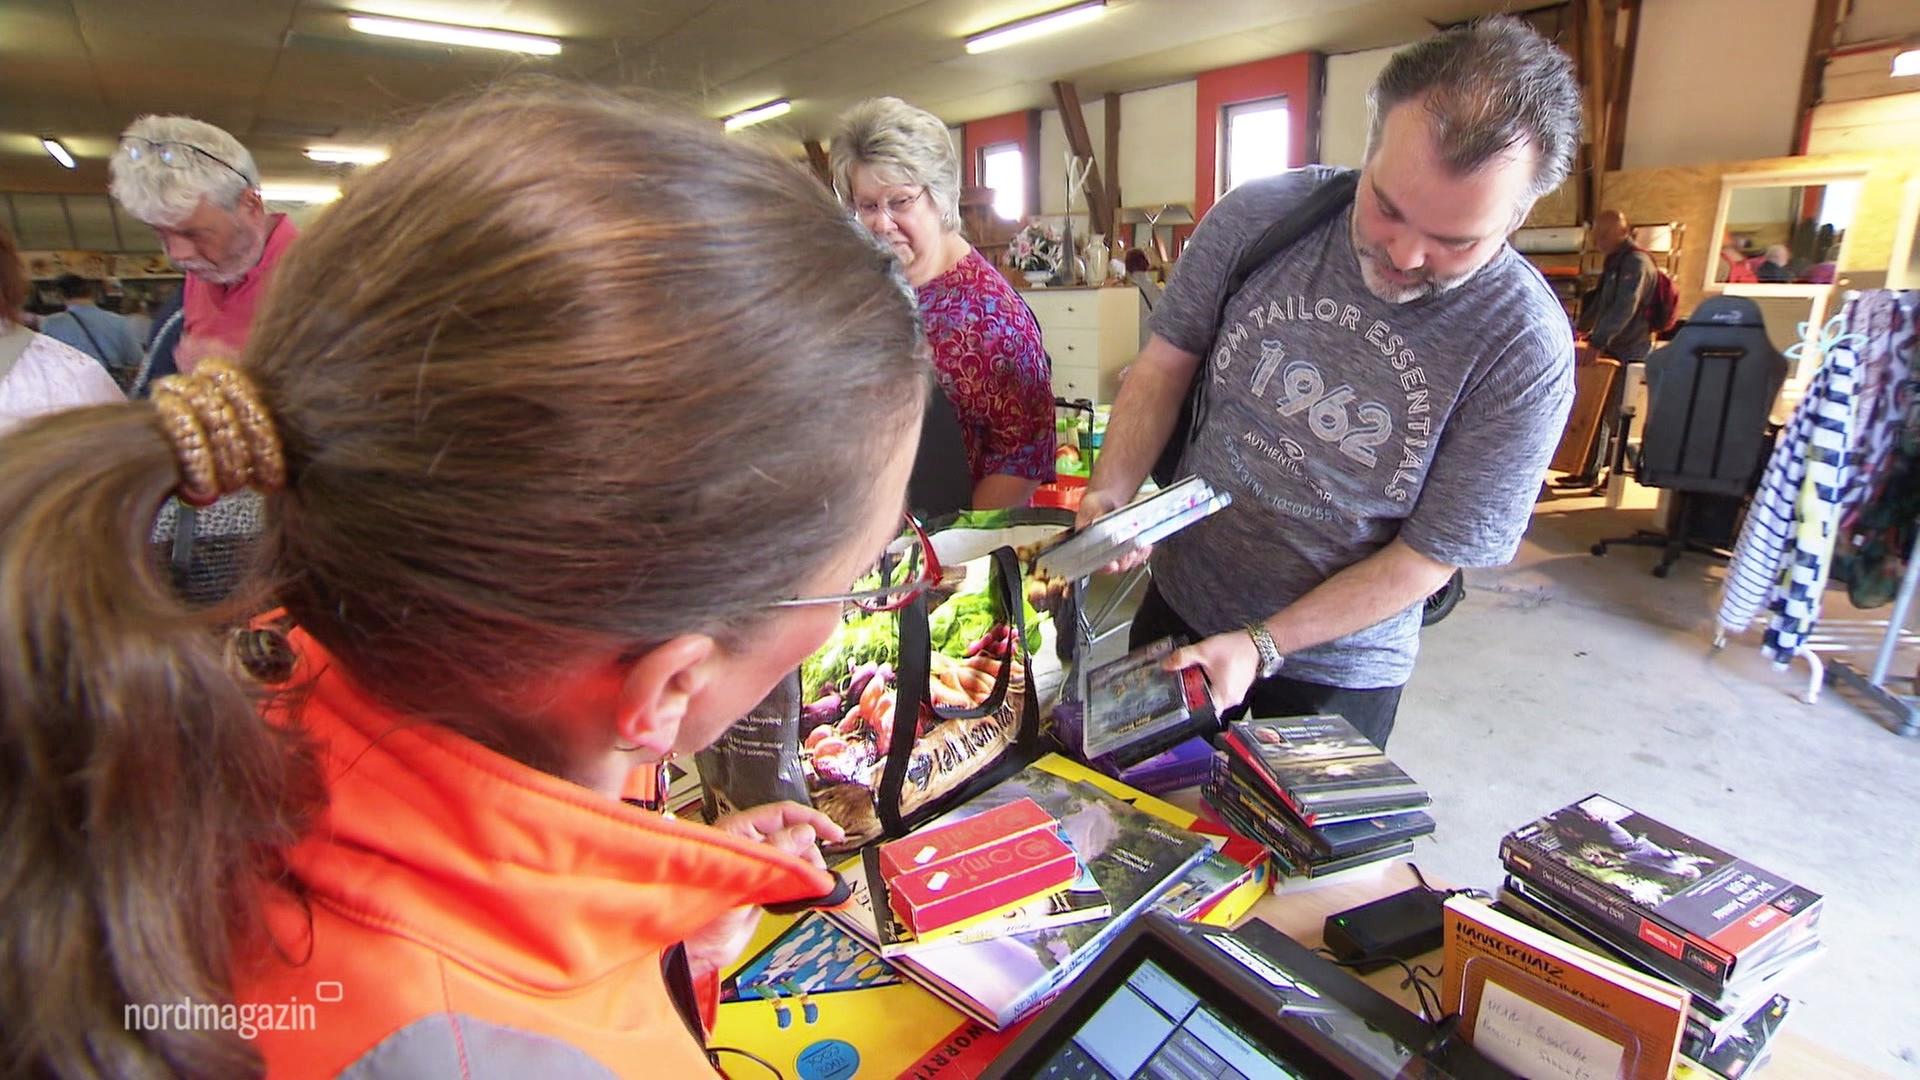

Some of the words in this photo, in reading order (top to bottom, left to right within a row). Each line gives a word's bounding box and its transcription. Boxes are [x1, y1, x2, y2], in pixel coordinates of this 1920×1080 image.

[1248, 294, 1361, 331] TAILOR
[1364, 318, 1431, 501] ESSENTIALS
[1249, 338, 1393, 469] 1962
